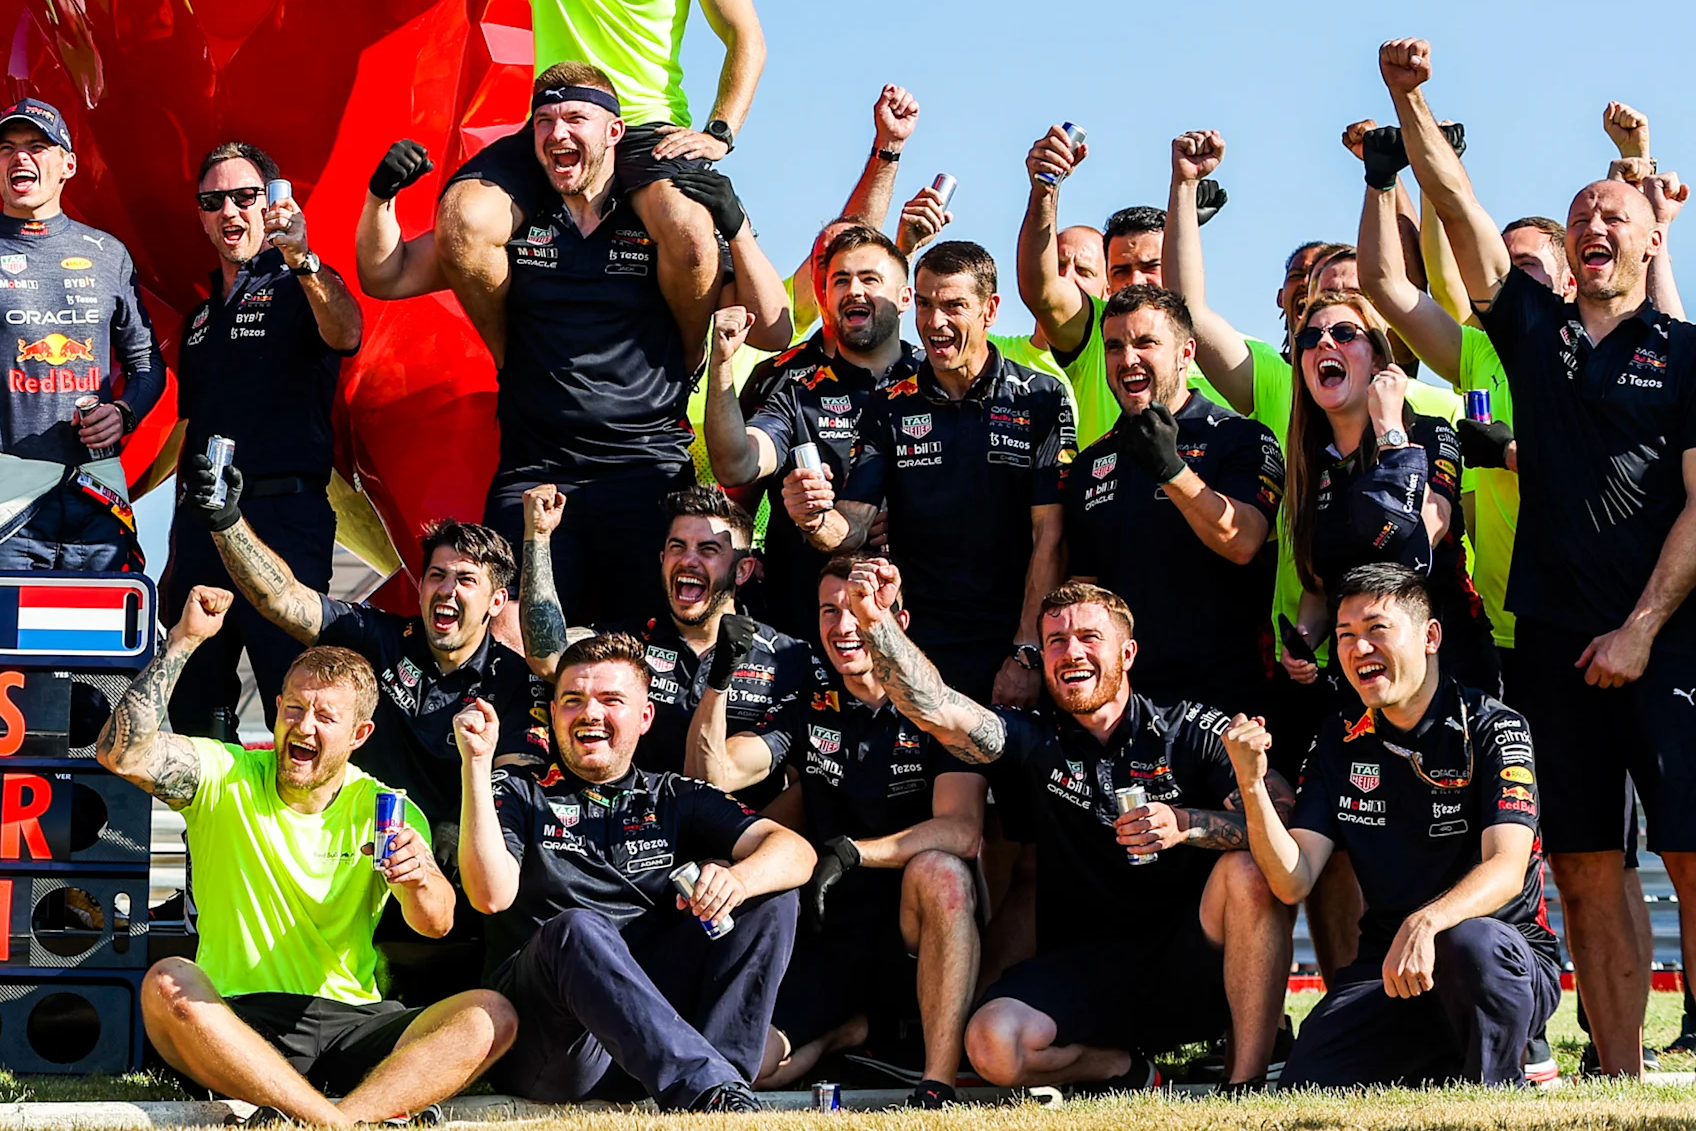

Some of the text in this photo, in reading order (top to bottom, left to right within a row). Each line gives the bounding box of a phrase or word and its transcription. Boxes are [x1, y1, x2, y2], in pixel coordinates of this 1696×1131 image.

[517, 247, 546, 258] Mobil
[620, 251, 650, 262] Tezos
[516, 258, 558, 269] ORACLE
[0, 280, 27, 289] Mobil
[64, 276, 96, 288] BYBIT
[75, 295, 98, 304] Tezos
[5, 309, 100, 325] ORACLE
[239, 327, 266, 338] Tezos
[8, 366, 101, 393] Red Bull
[1628, 374, 1664, 388] Tezos
[824, 397, 849, 405] TAG
[818, 416, 849, 429] Mobil
[905, 416, 931, 426] TAG
[1001, 434, 1031, 450] Tezos
[896, 443, 928, 457] Mobil
[897, 456, 942, 468] ORACLE
[1095, 454, 1117, 467] TAG
[1403, 472, 1419, 514] CarNext
[1085, 492, 1115, 511] ORACLE
[651, 648, 675, 662] TAG
[402, 658, 420, 679] TAG
[650, 676, 665, 690] bil
[648, 691, 676, 705] ACLE
[740, 690, 773, 704] Tezos
[816, 728, 840, 742] TAG
[890, 763, 922, 776] Tezos
[1354, 765, 1380, 776] TAG
[1050, 769, 1083, 794] Mobil
[1351, 775, 1380, 791] HEUER
[1047, 782, 1092, 810] ORACLE
[1339, 796, 1373, 812] Mobil
[1498, 799, 1520, 810] Red
[1337, 812, 1387, 826] ORACLE
[639, 838, 669, 851] Tezos
[640, 859, 663, 868] ADAM
